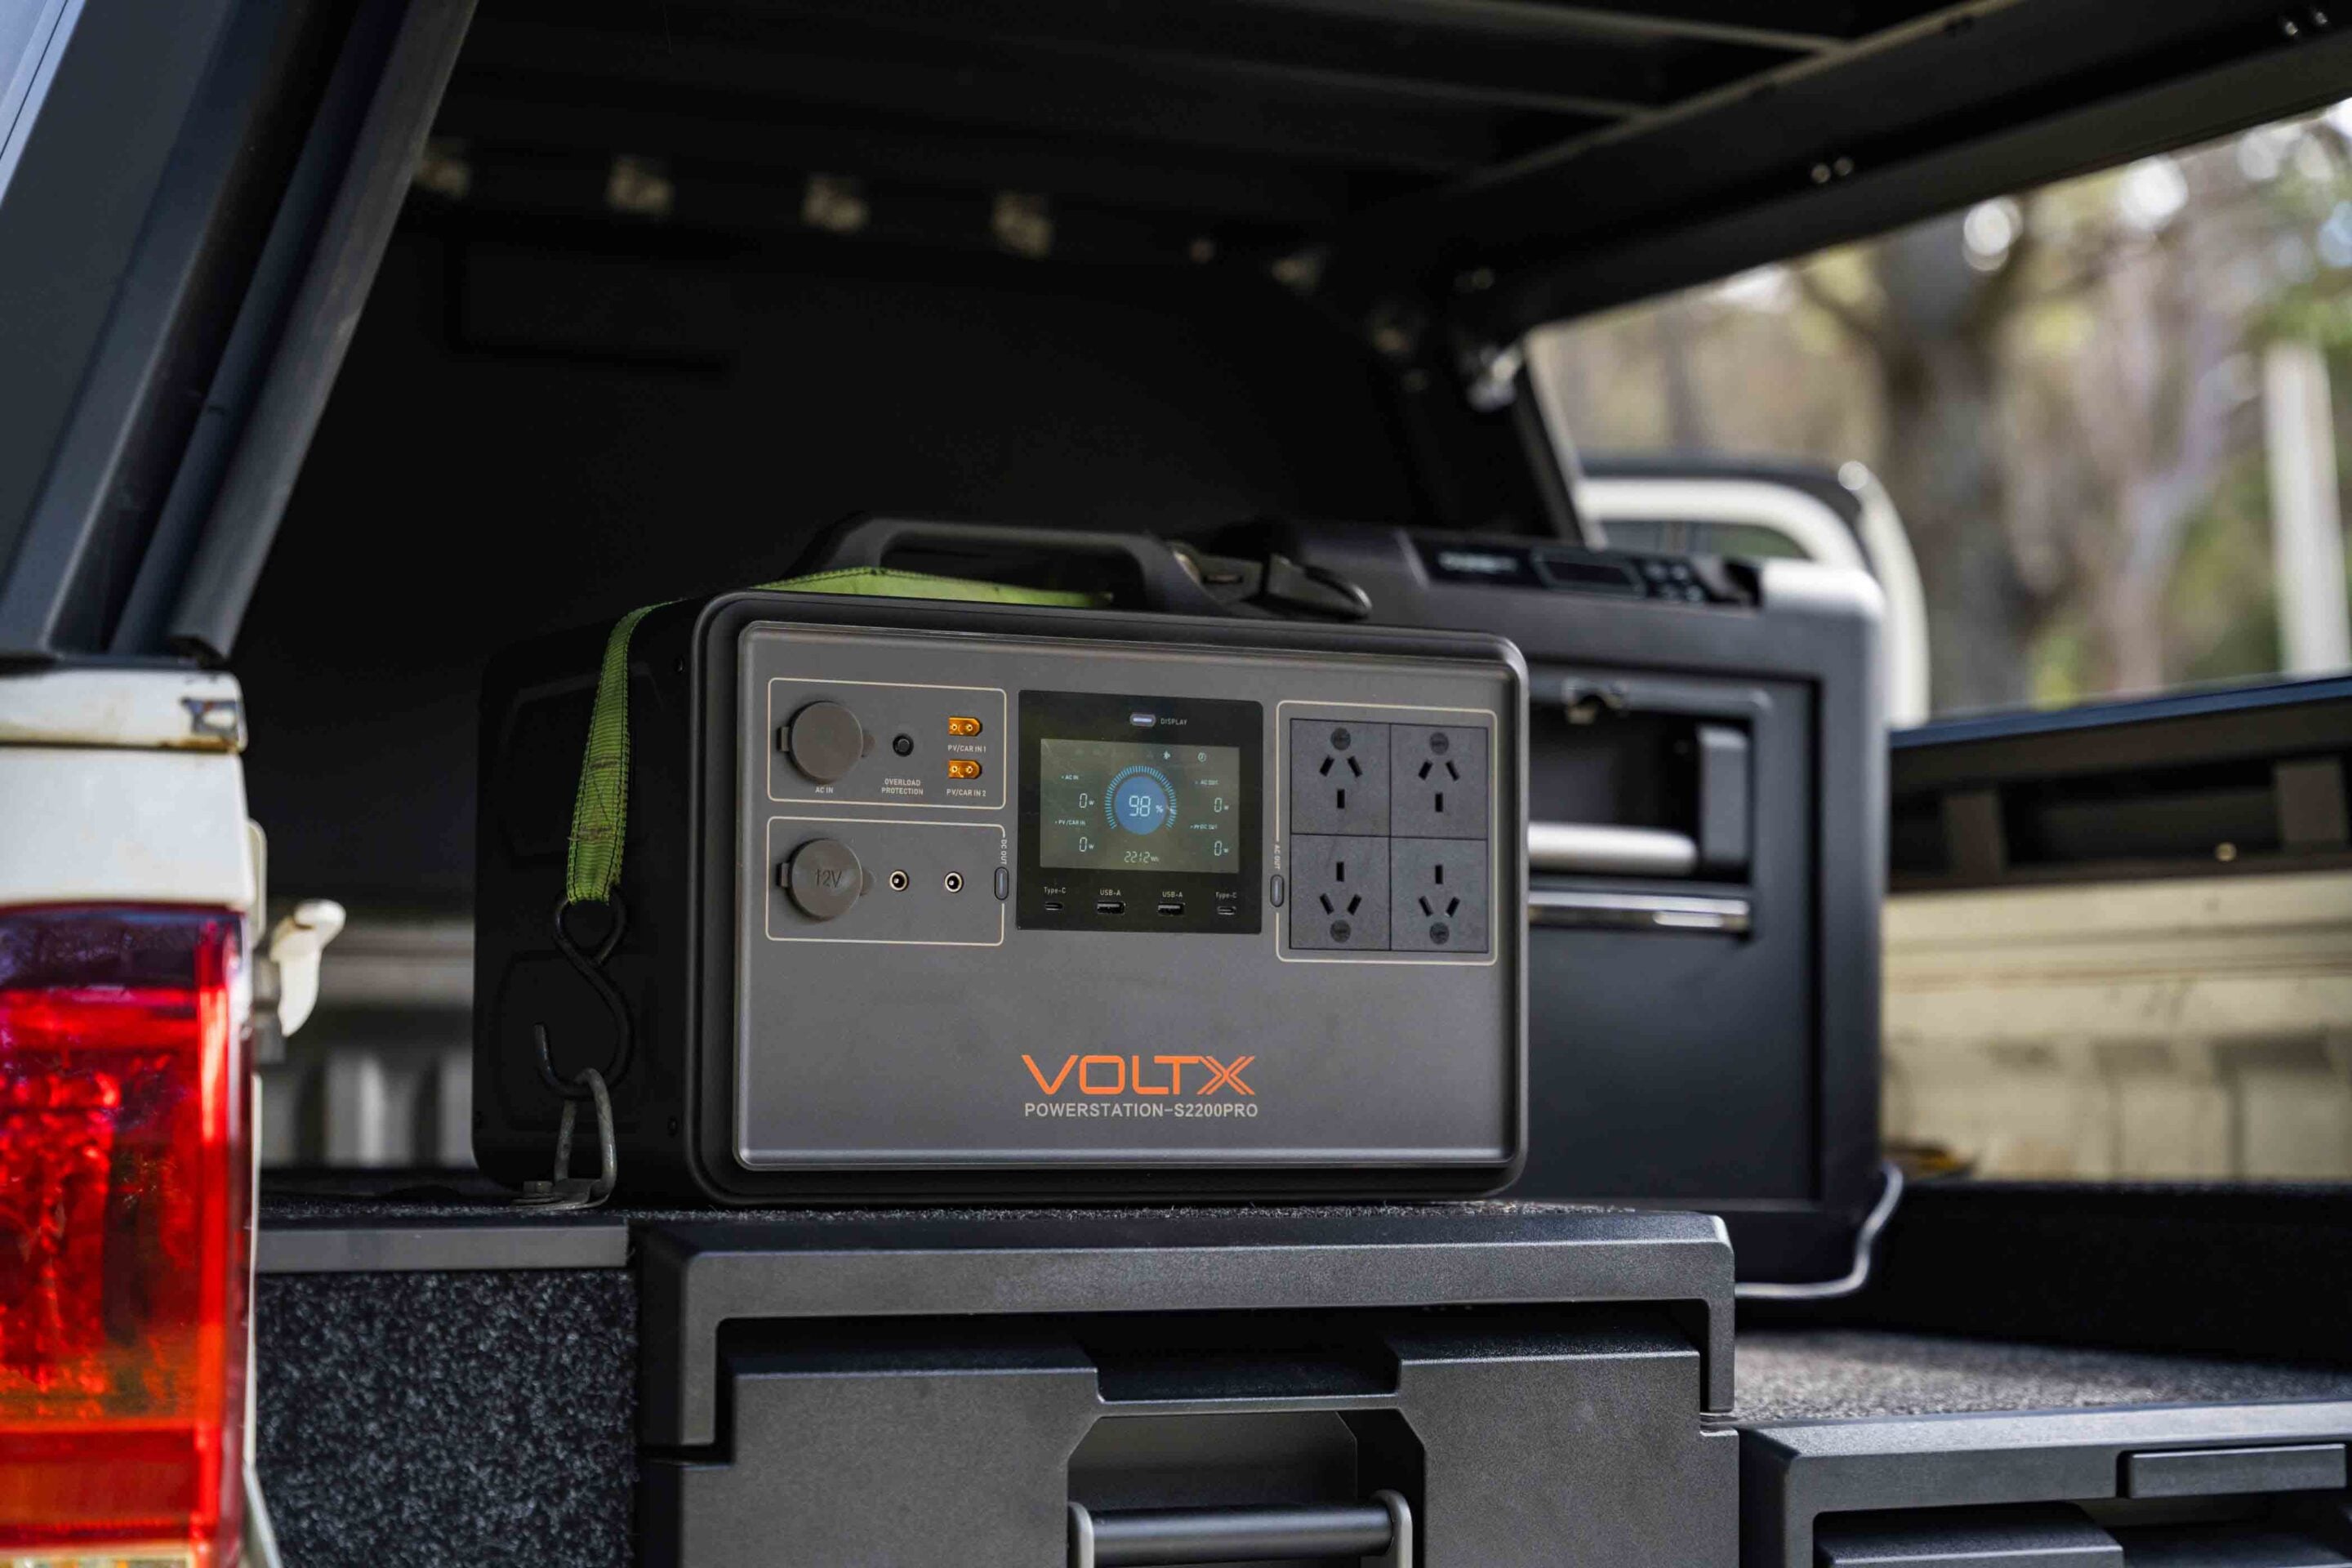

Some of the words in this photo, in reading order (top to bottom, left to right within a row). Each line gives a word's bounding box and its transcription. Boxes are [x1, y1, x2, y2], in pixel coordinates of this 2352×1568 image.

[947, 744, 973, 752] PV/CAR
[884, 778, 921, 786] OVERLOAD
[881, 786, 924, 796] PROTECTION
[1129, 795, 1152, 817] 98
[1000, 840, 1007, 849] DC
[814, 868, 842, 887] 12V
[1044, 886, 1067, 895] Type-C
[1215, 892, 1237, 900] Type-C
[1021, 1054, 1255, 1096] VOLTX
[1025, 1102, 1258, 1118] POWERSTATION-S2200PRO
